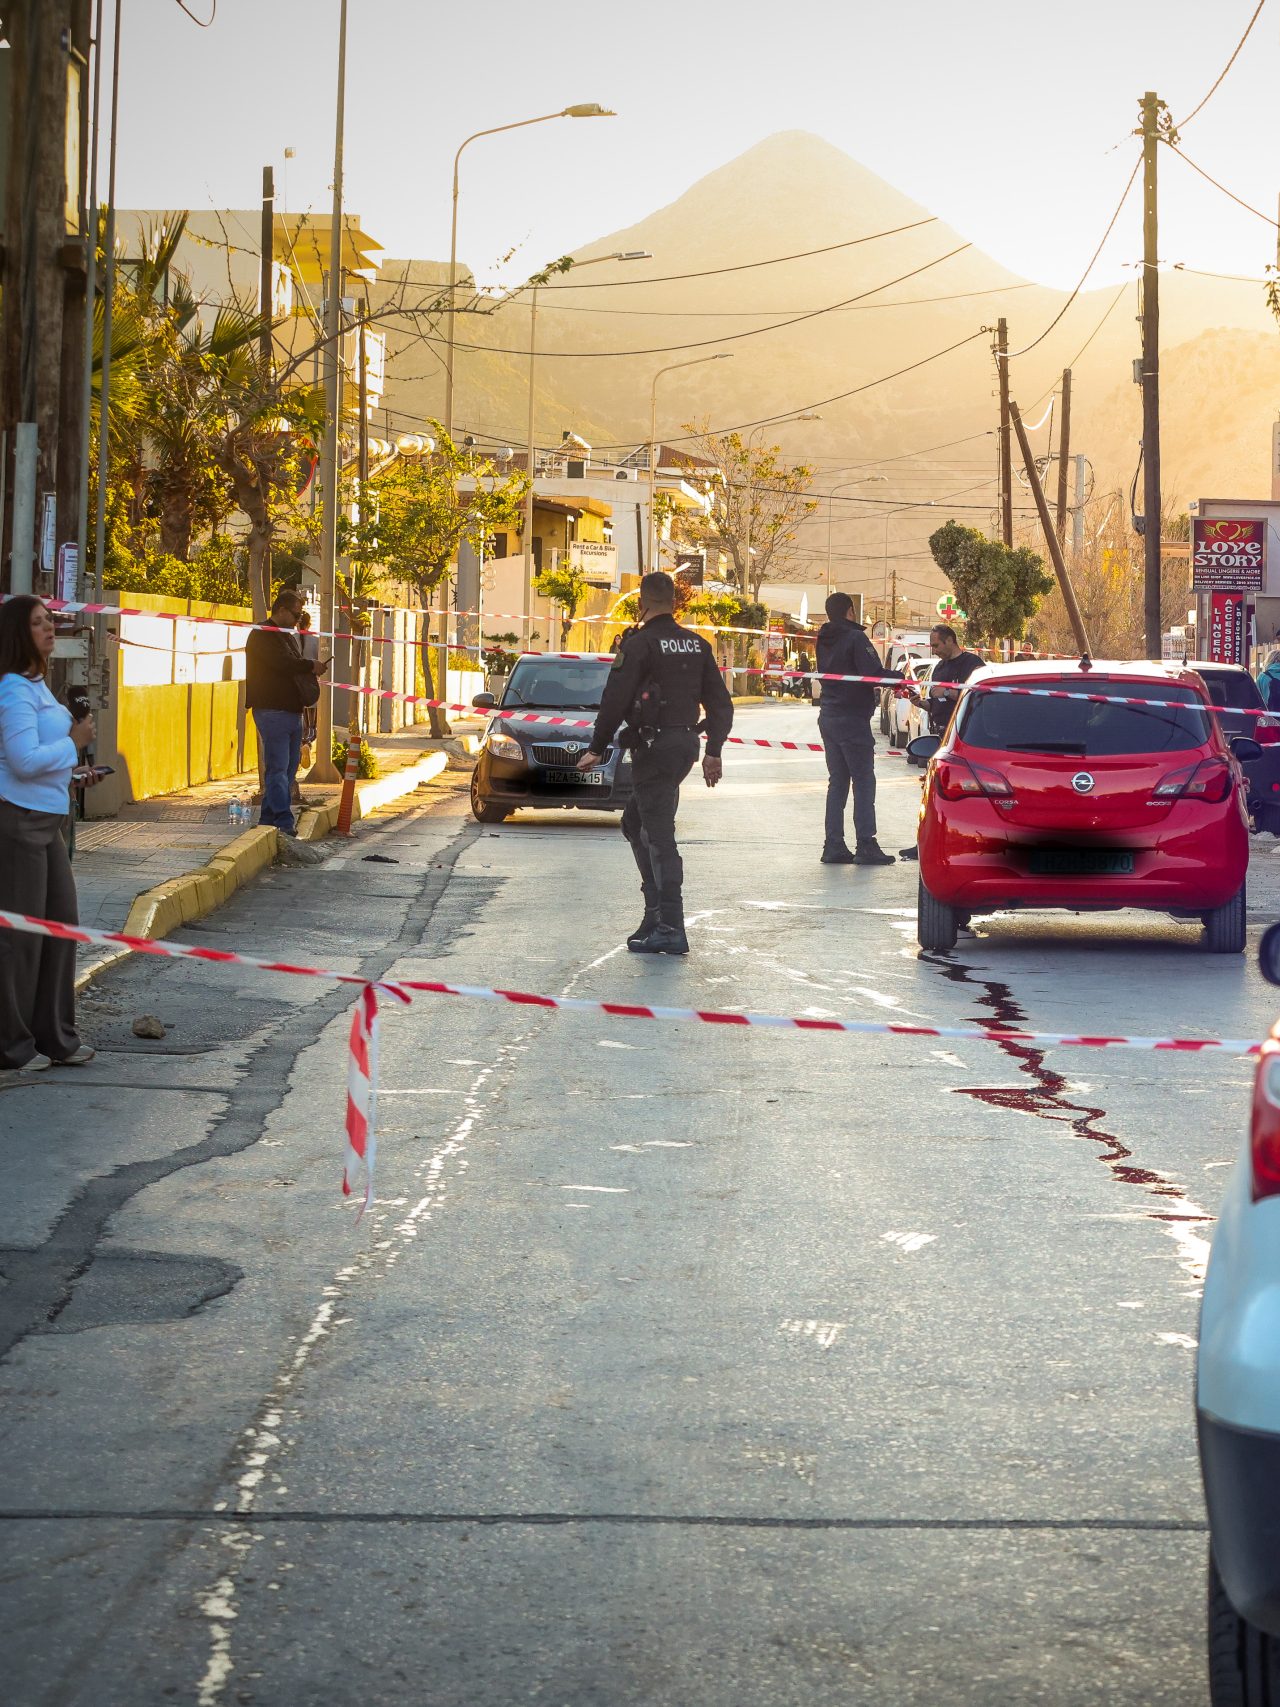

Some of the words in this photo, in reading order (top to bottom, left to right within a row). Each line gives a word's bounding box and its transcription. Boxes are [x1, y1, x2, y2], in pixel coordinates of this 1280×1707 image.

[1194, 554, 1261, 566] STORY
[660, 639, 701, 653] POLICE
[1213, 607, 1222, 661] LINGERI
[1224, 599, 1233, 664] ACCESSORI
